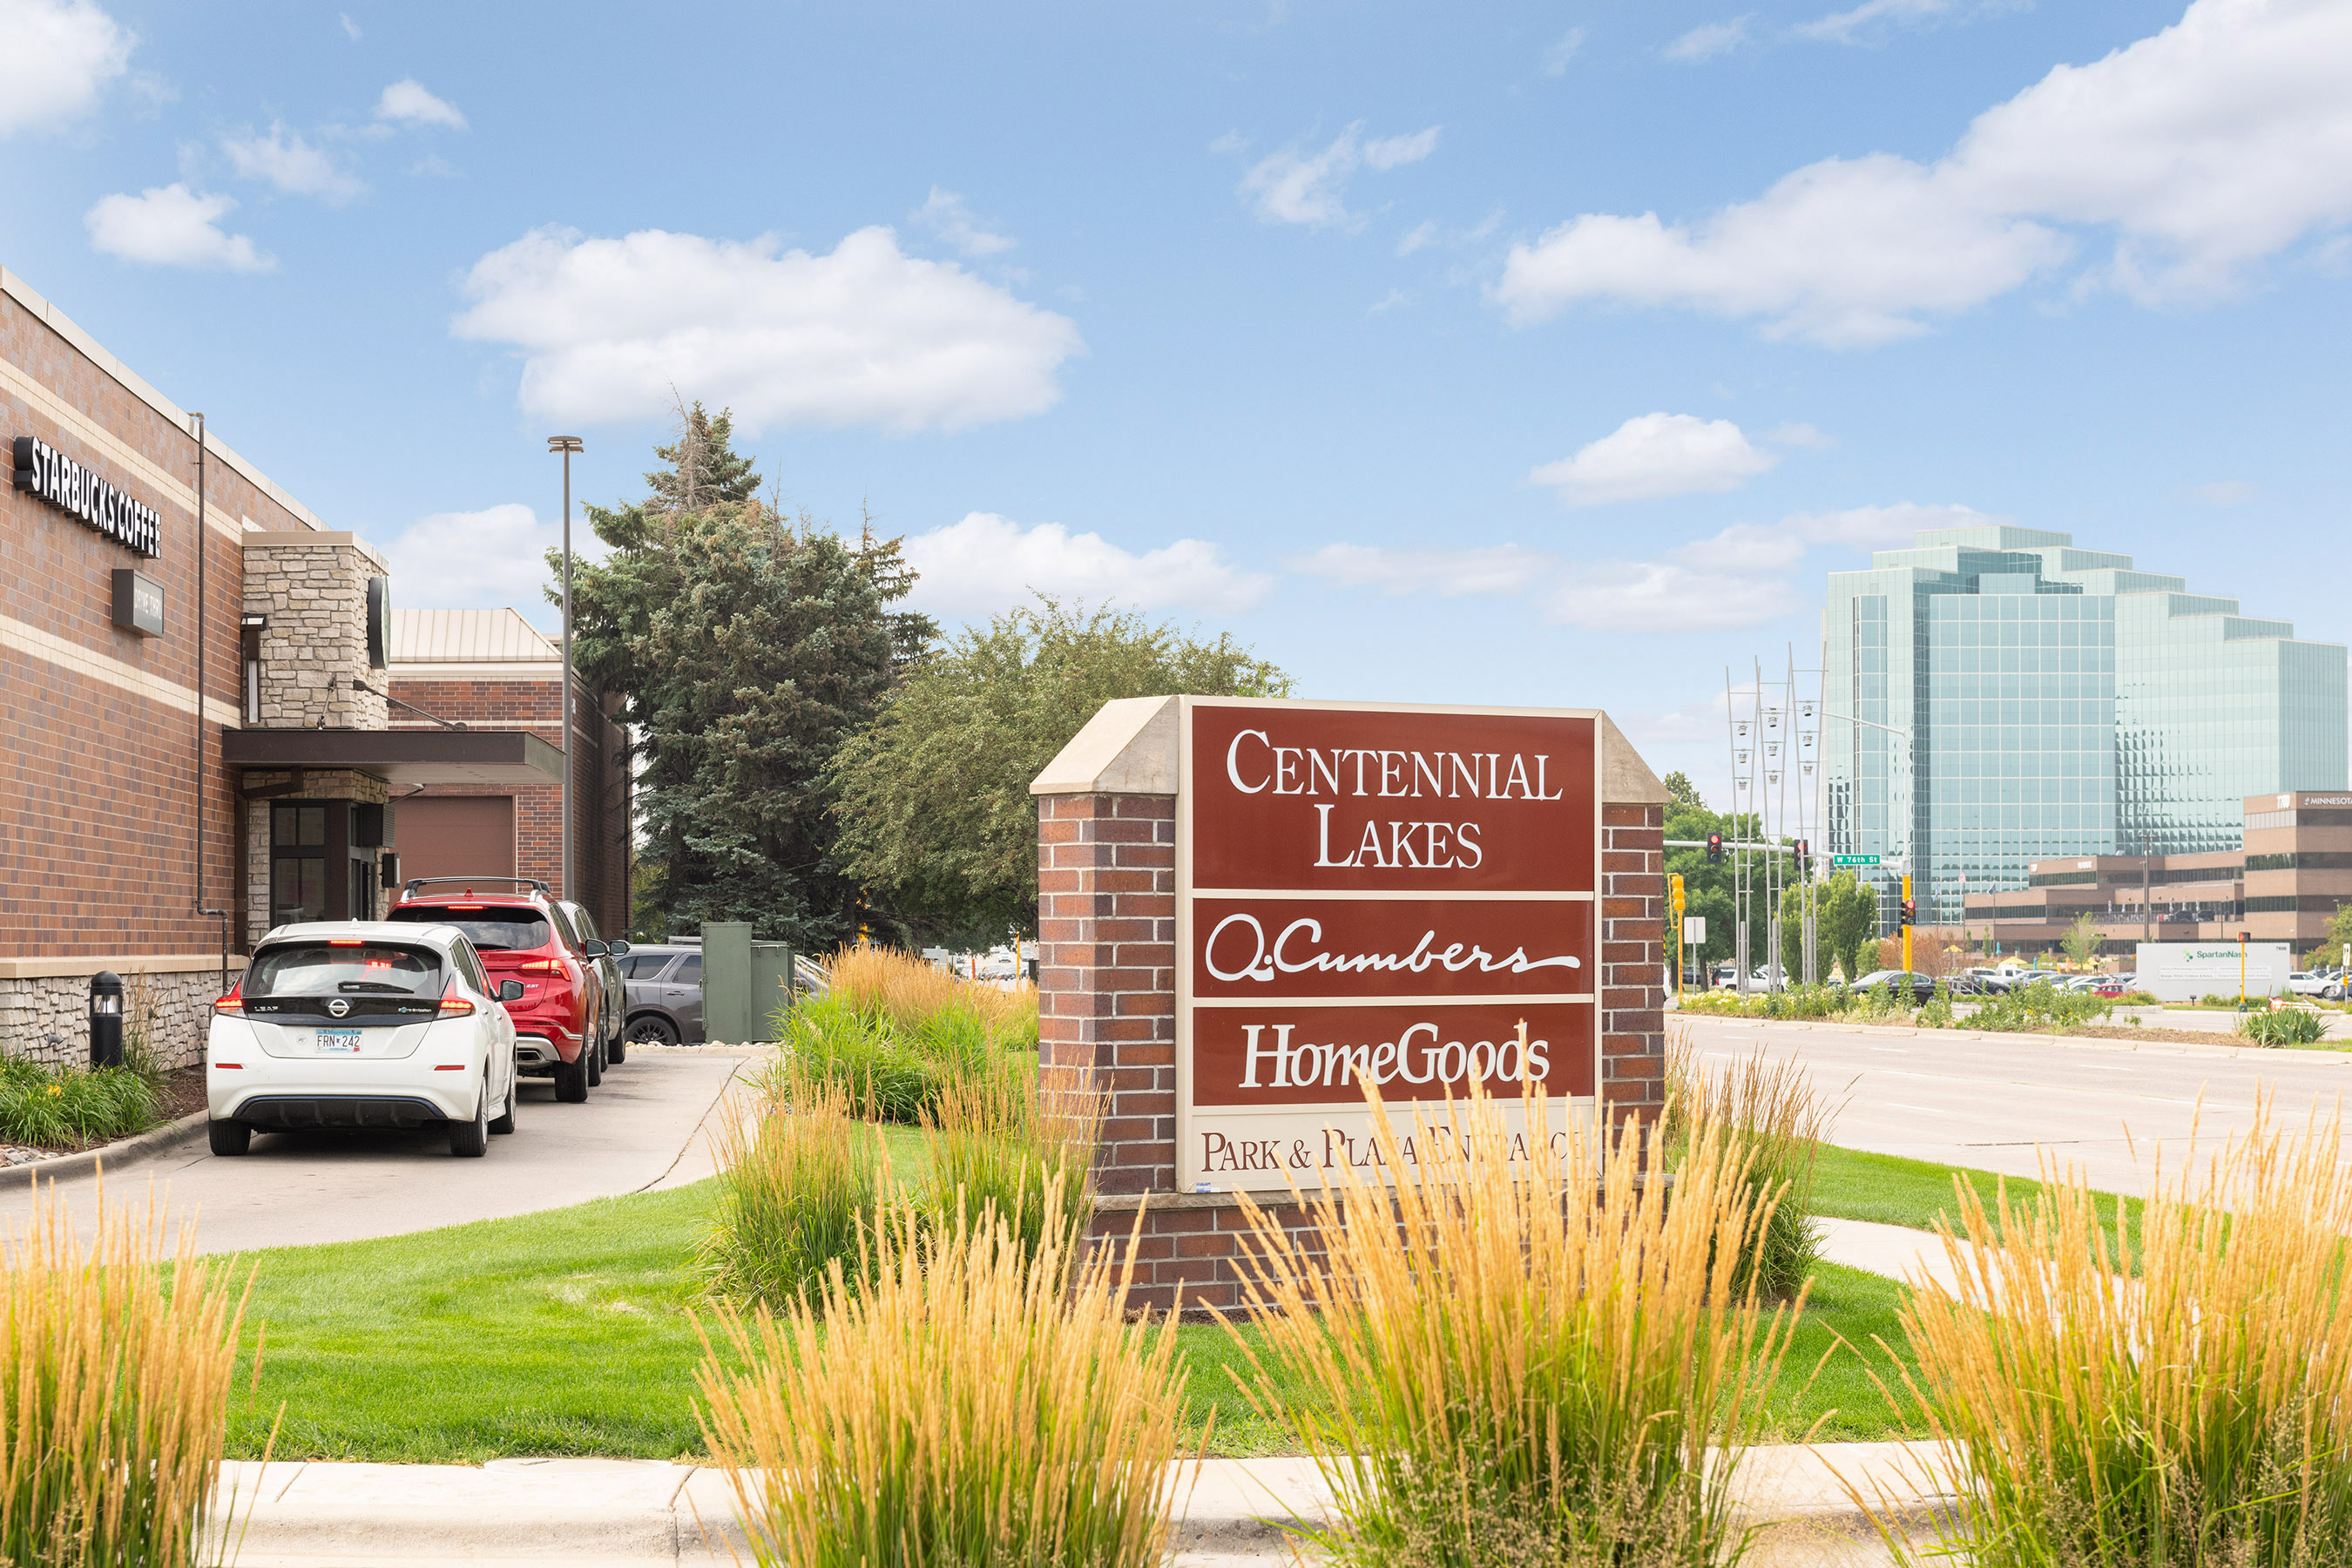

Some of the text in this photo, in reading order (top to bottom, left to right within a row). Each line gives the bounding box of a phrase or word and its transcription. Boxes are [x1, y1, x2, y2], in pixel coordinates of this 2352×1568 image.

[32, 436, 162, 559] STARBUCKS COFFEE
[1226, 728, 1563, 801] CENTENNIAL
[1313, 803, 1483, 870] LAKES
[317, 1035, 360, 1047] FRN 242
[1238, 1022, 1551, 1089] HomeGoods
[1200, 1132, 1281, 1173] PARK
[1288, 1139, 1313, 1169] &
[1321, 1127, 1419, 1168] PLAA
